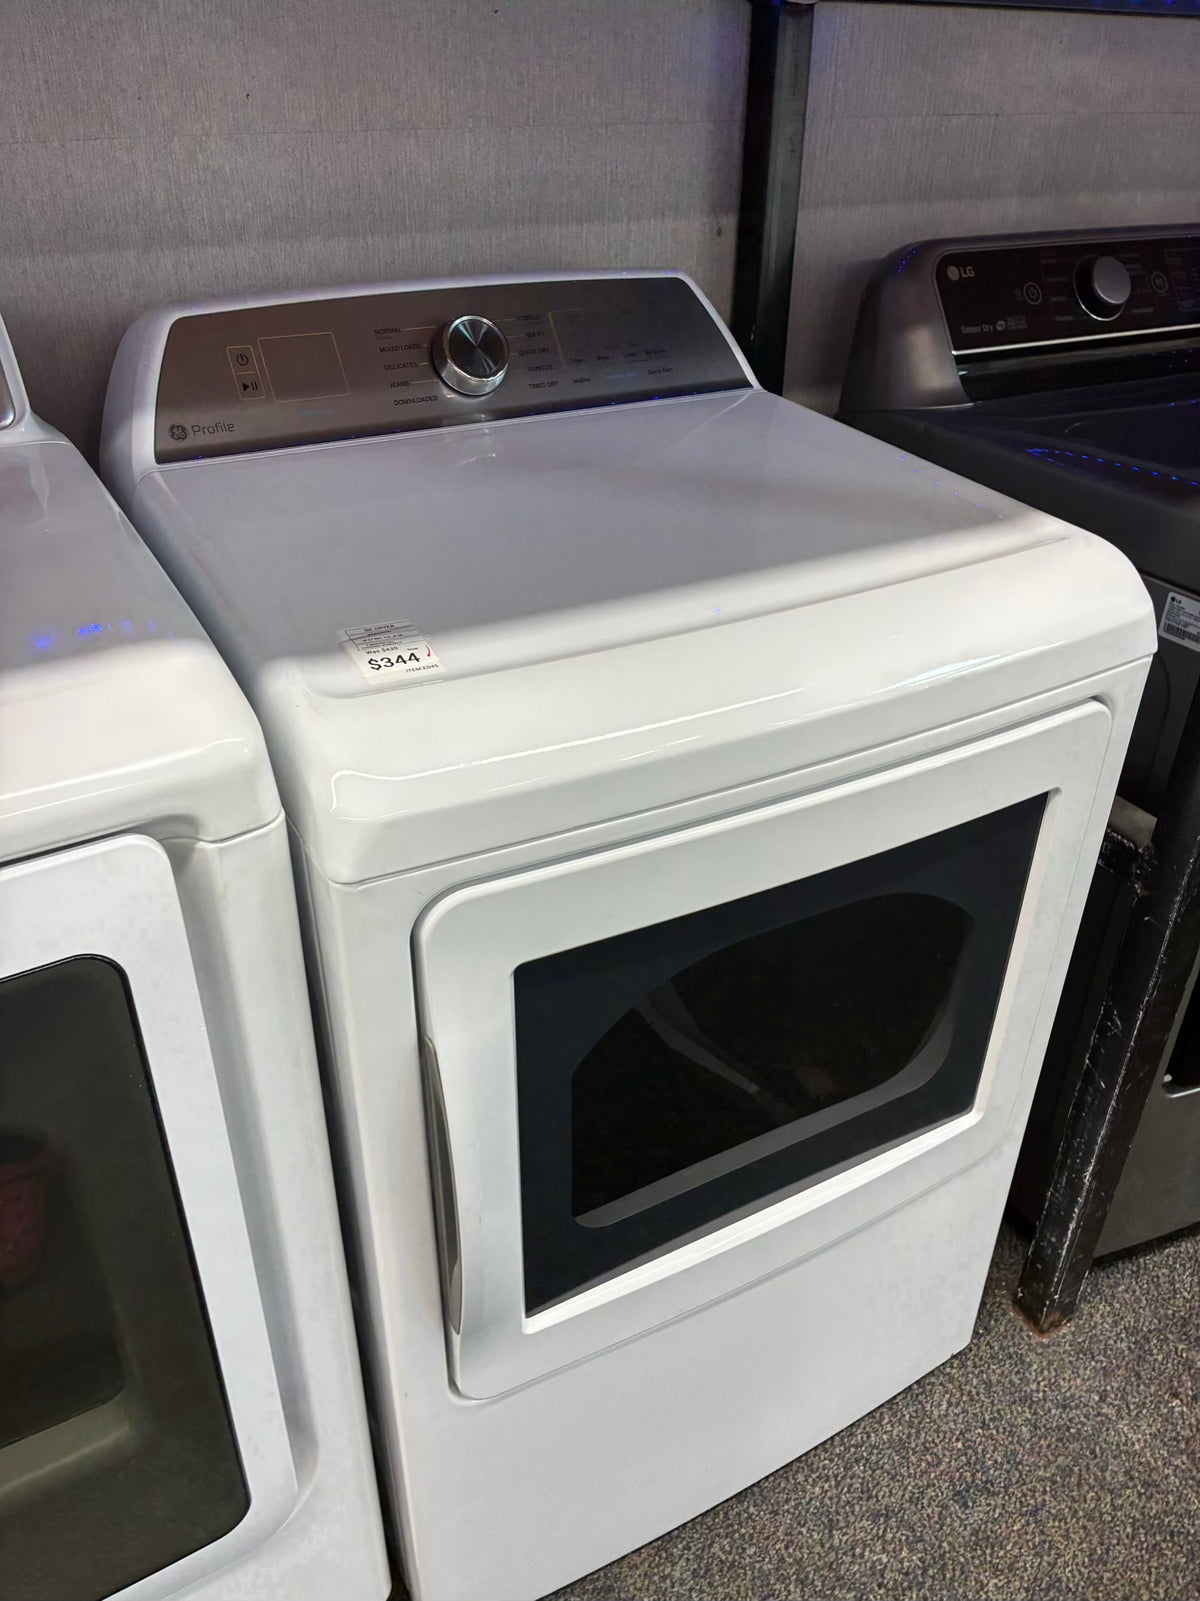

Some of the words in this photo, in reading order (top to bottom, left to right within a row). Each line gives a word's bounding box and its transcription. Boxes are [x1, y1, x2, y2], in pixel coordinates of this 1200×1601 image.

[960, 266, 975, 277] LG
[374, 327, 402, 335] NORMAL
[400, 343, 422, 351] LOADS
[384, 361, 418, 371] DELICATES
[528, 382, 547, 390] TIMED
[546, 380, 559, 388] DRY
[393, 394, 438, 406] DOWNLOADED
[191, 421, 235, 437] Profile
[367, 652, 421, 671] $344
